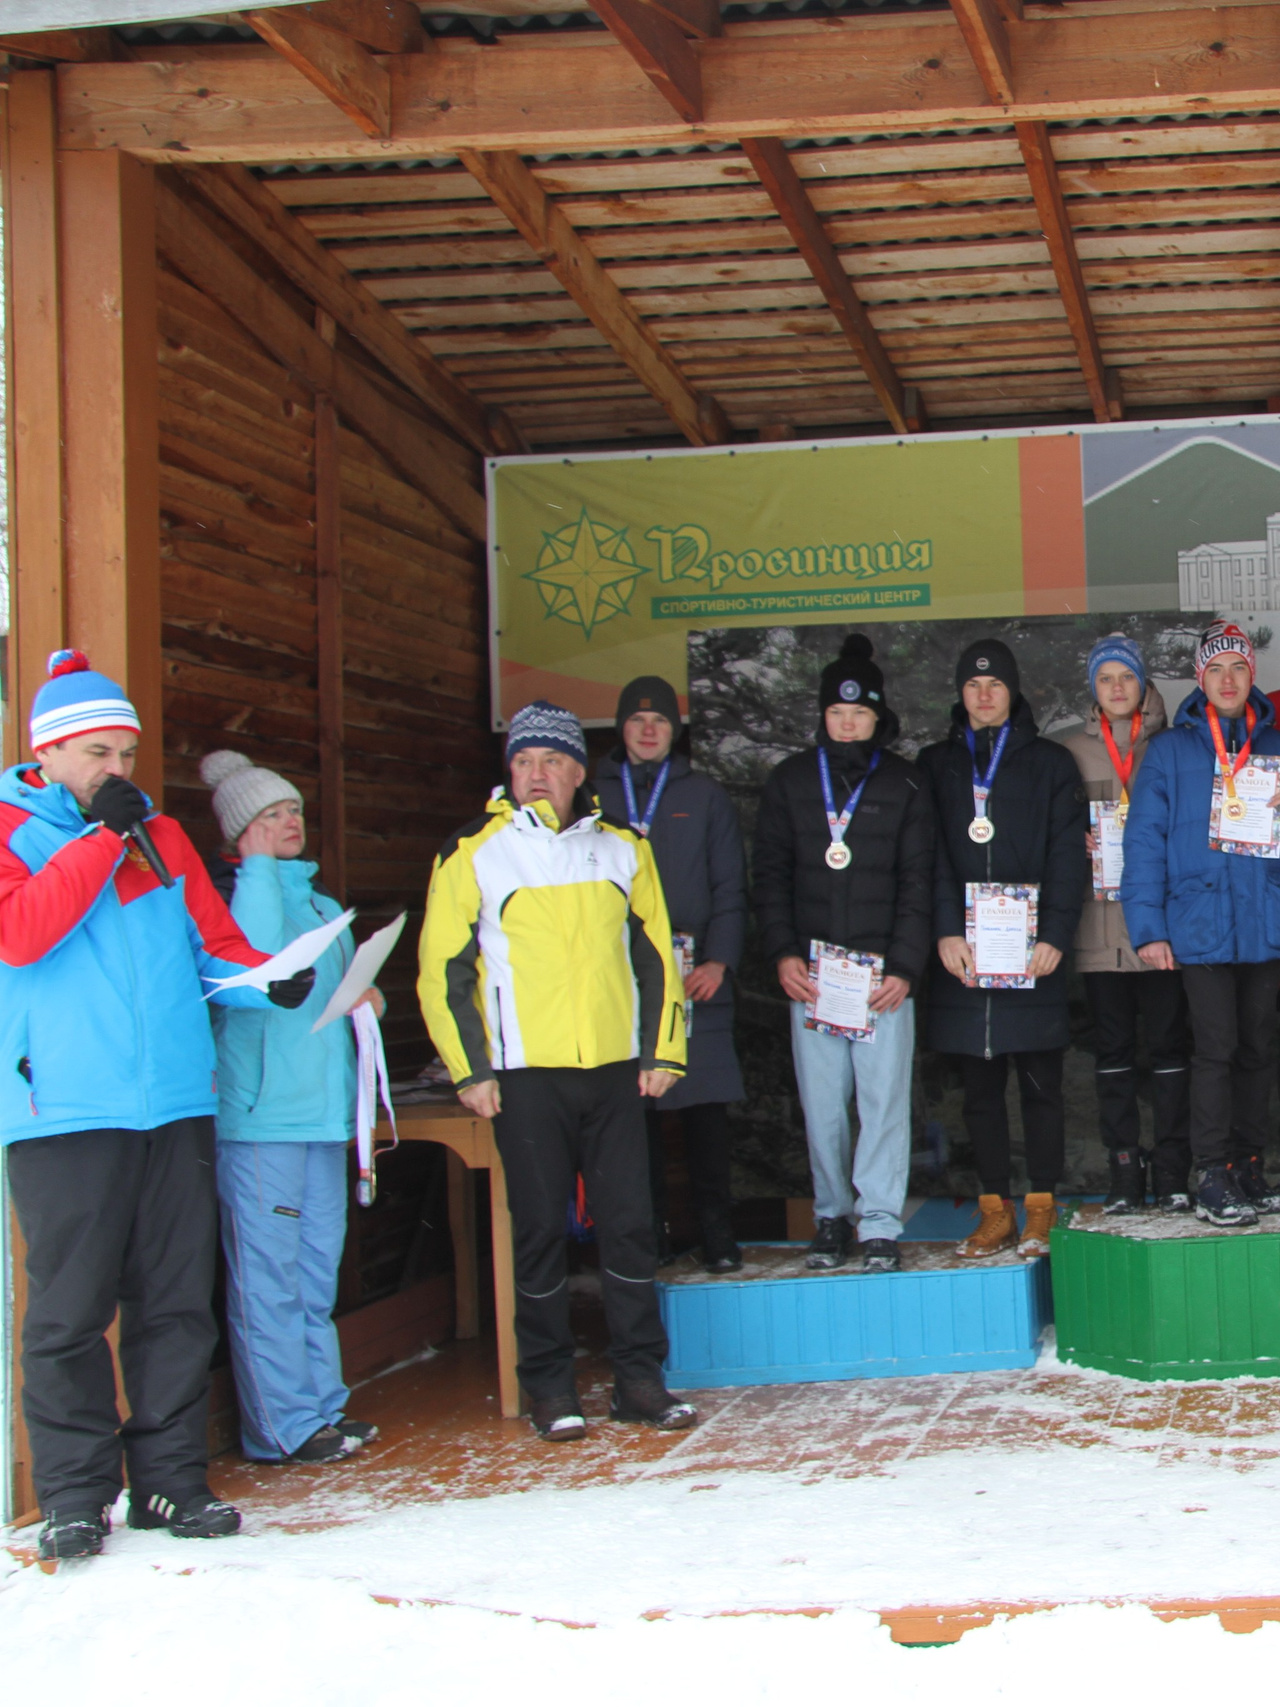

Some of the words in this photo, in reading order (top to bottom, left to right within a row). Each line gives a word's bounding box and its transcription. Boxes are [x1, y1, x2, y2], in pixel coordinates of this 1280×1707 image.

[644, 523, 932, 592] Провинция
[659, 590, 871, 615] СПОРТИВНО-ТУРИСТИЧЕСКИЙ
[874, 590, 922, 605] ЦЕНТР
[1199, 636, 1247, 665] EUROPE
[1234, 777, 1270, 786] РАМОТА
[981, 907, 1022, 915] ГРАМОТА
